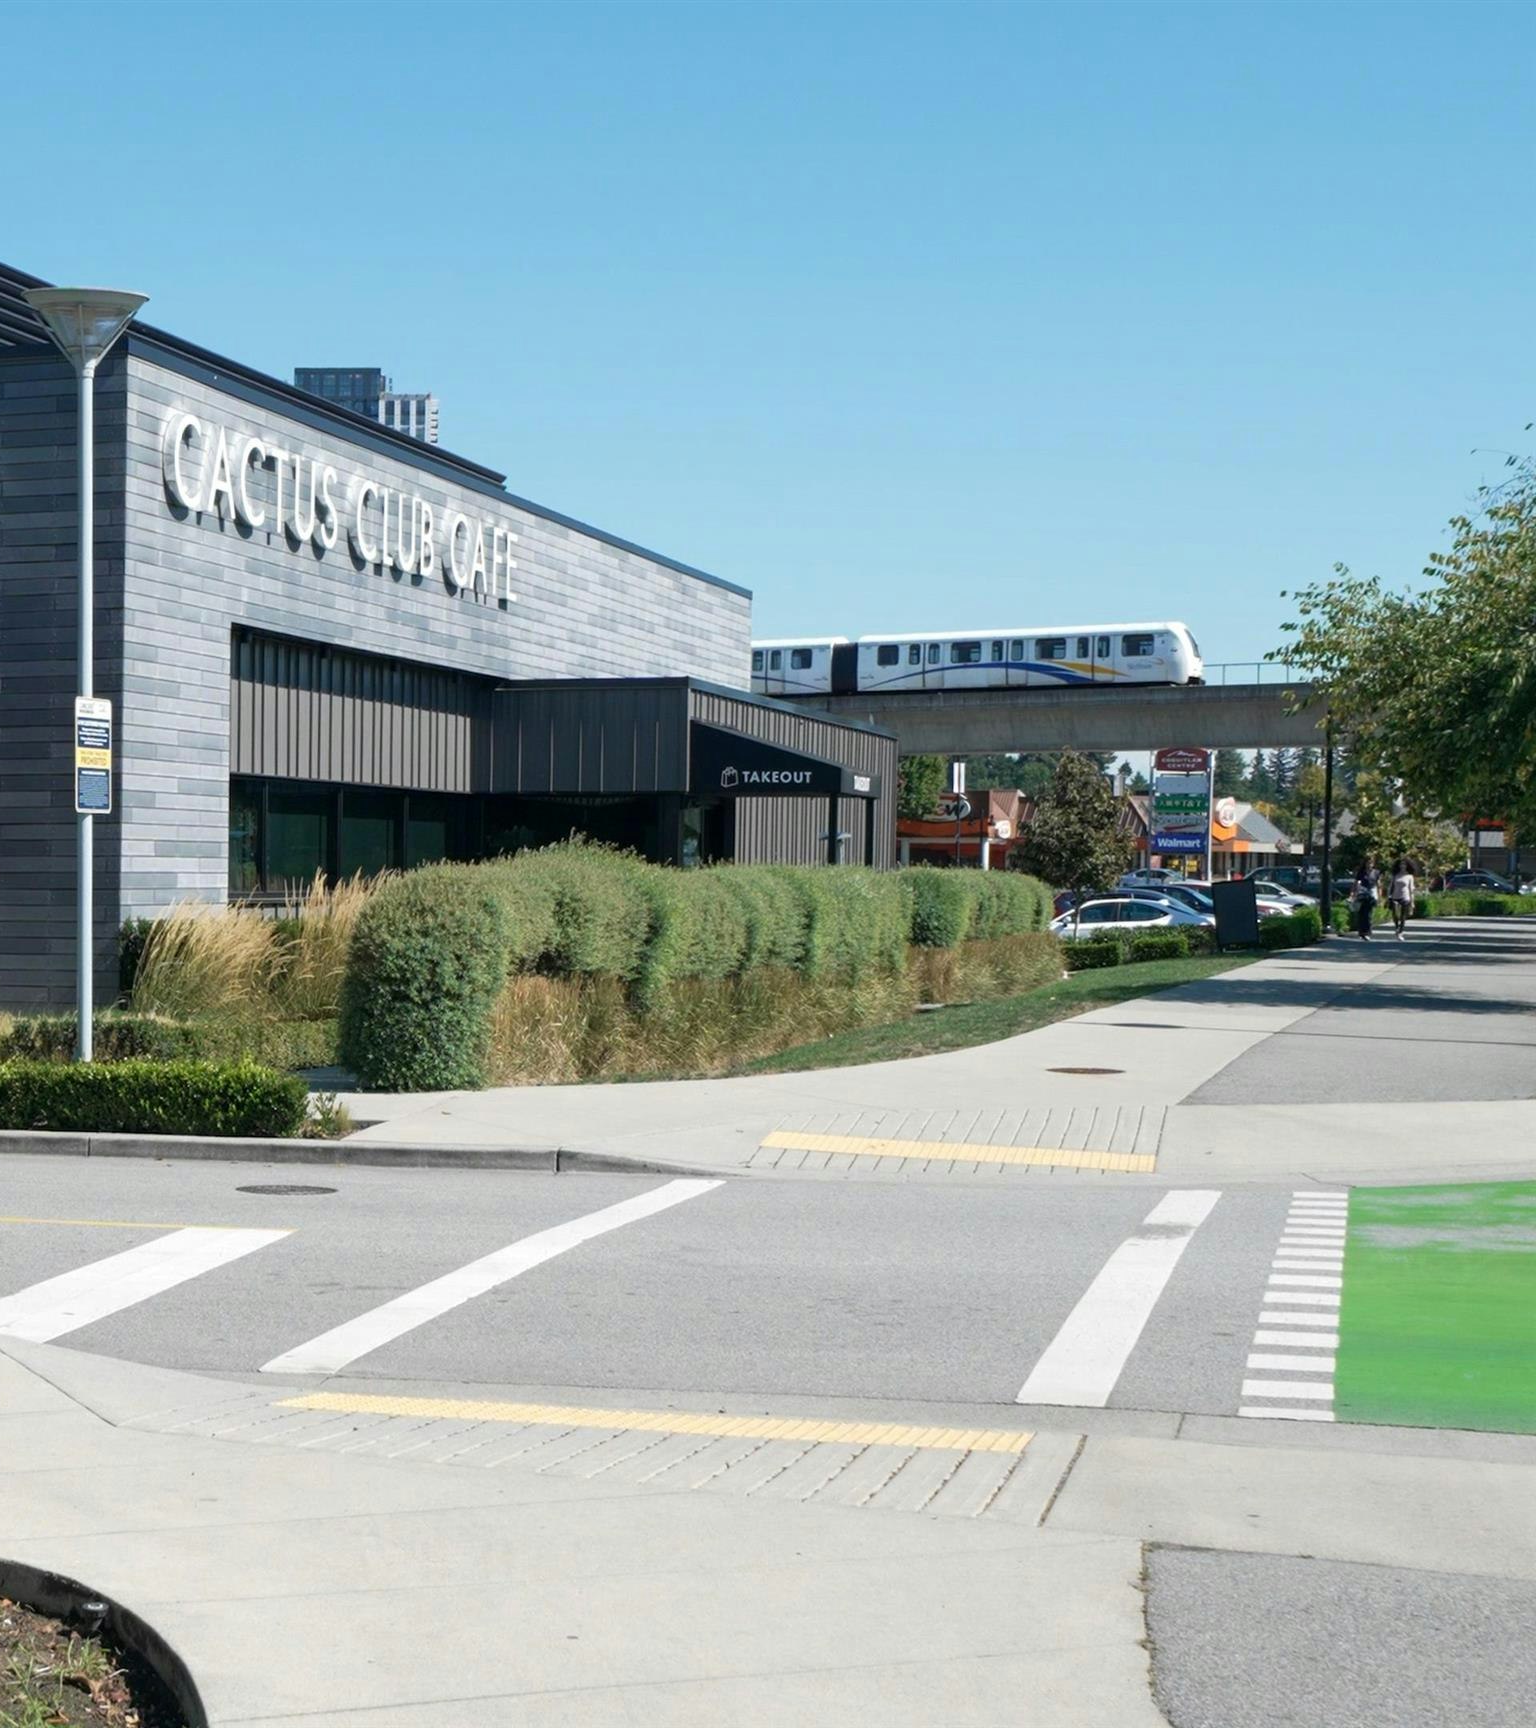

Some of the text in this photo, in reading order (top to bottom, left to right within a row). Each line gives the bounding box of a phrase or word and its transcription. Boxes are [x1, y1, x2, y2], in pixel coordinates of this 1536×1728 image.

[170, 413, 519, 602] CACTUS CLUB CAFE
[742, 771, 813, 783] TAKEOUT
[1157, 837, 1201, 848] Walmart
